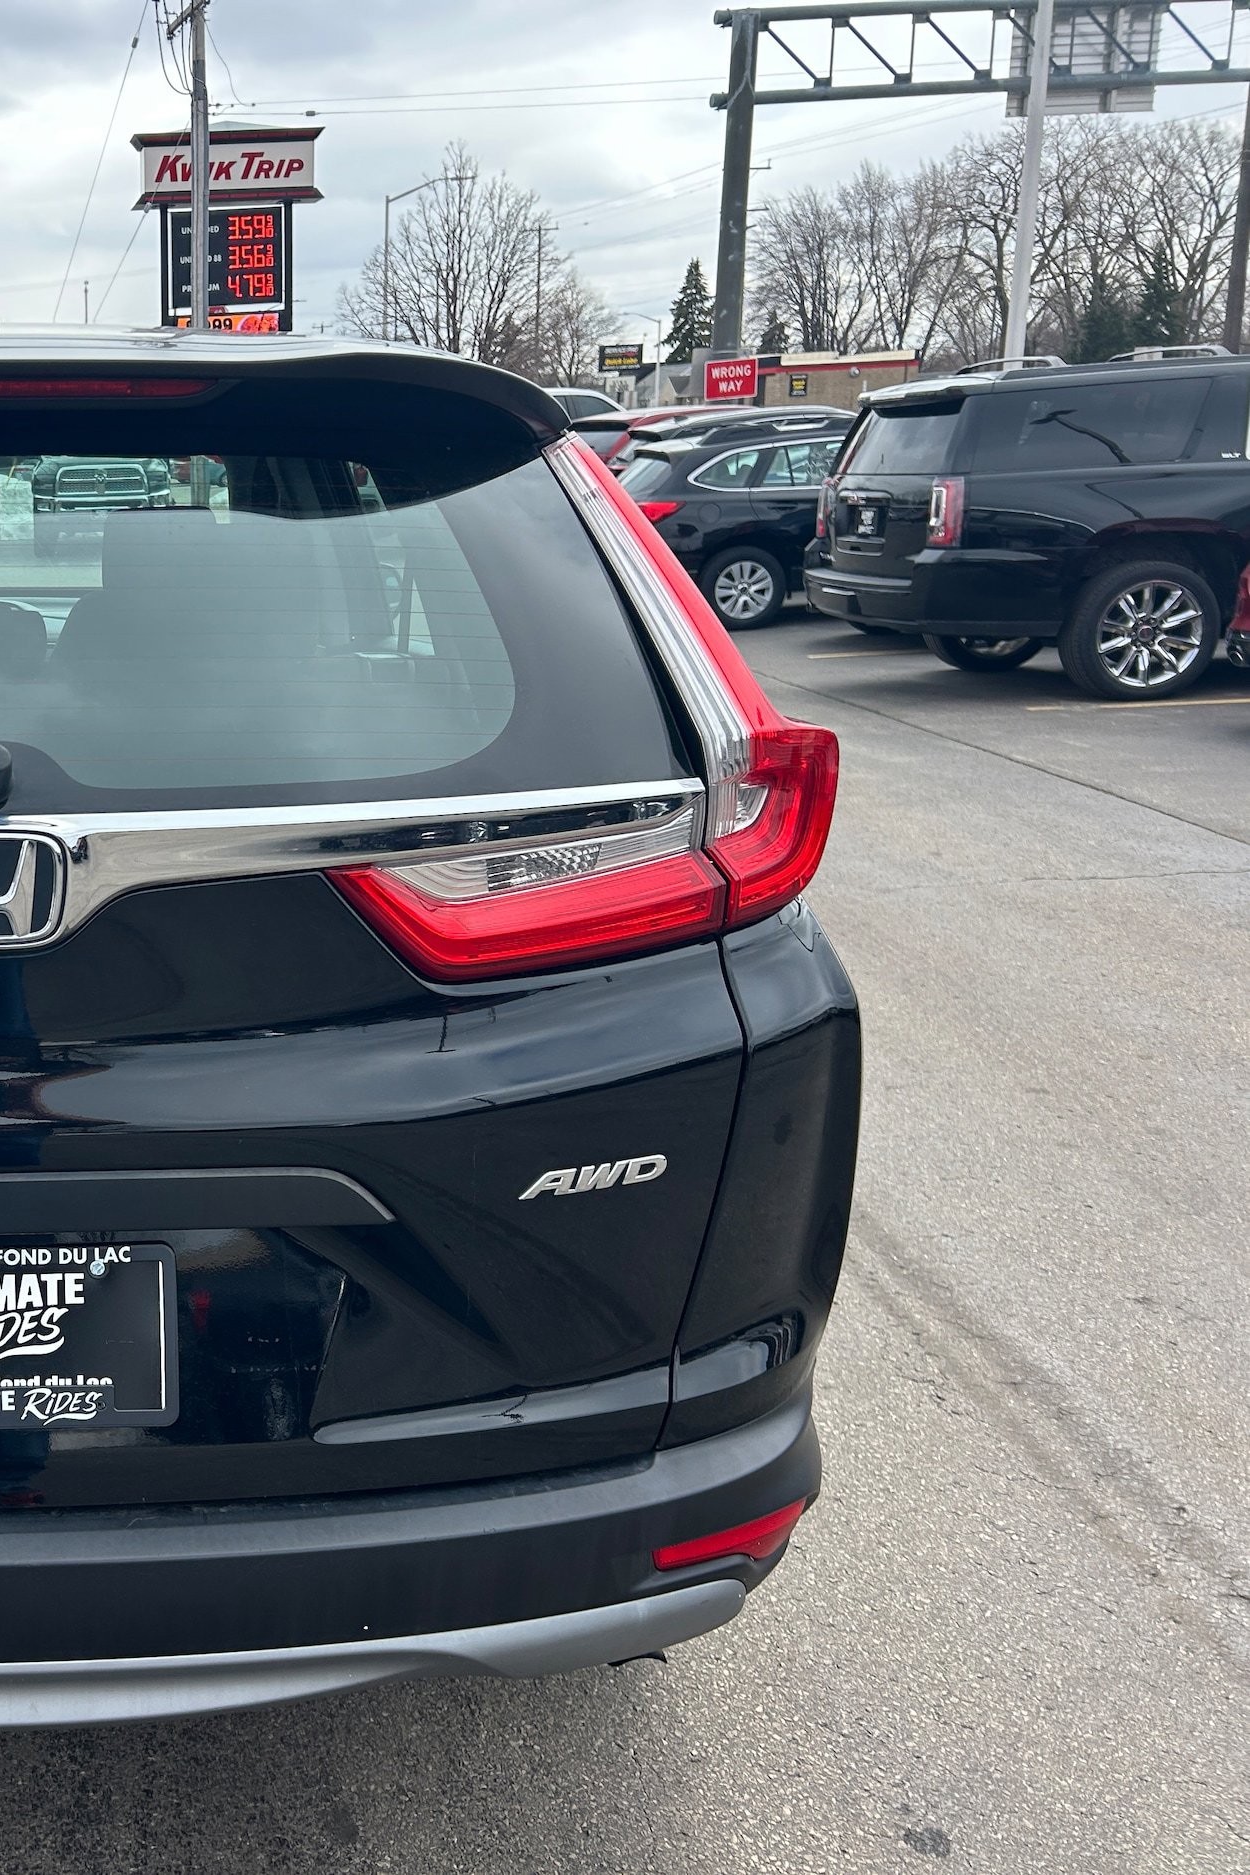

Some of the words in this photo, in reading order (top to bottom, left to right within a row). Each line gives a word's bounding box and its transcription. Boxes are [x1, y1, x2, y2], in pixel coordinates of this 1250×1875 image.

[711, 364, 751, 379] WRONG
[718, 380, 743, 393] WAY
[518, 1154, 668, 1200] AWD
[58, 1247, 87, 1265] DU
[93, 1245, 132, 1264] LAC
